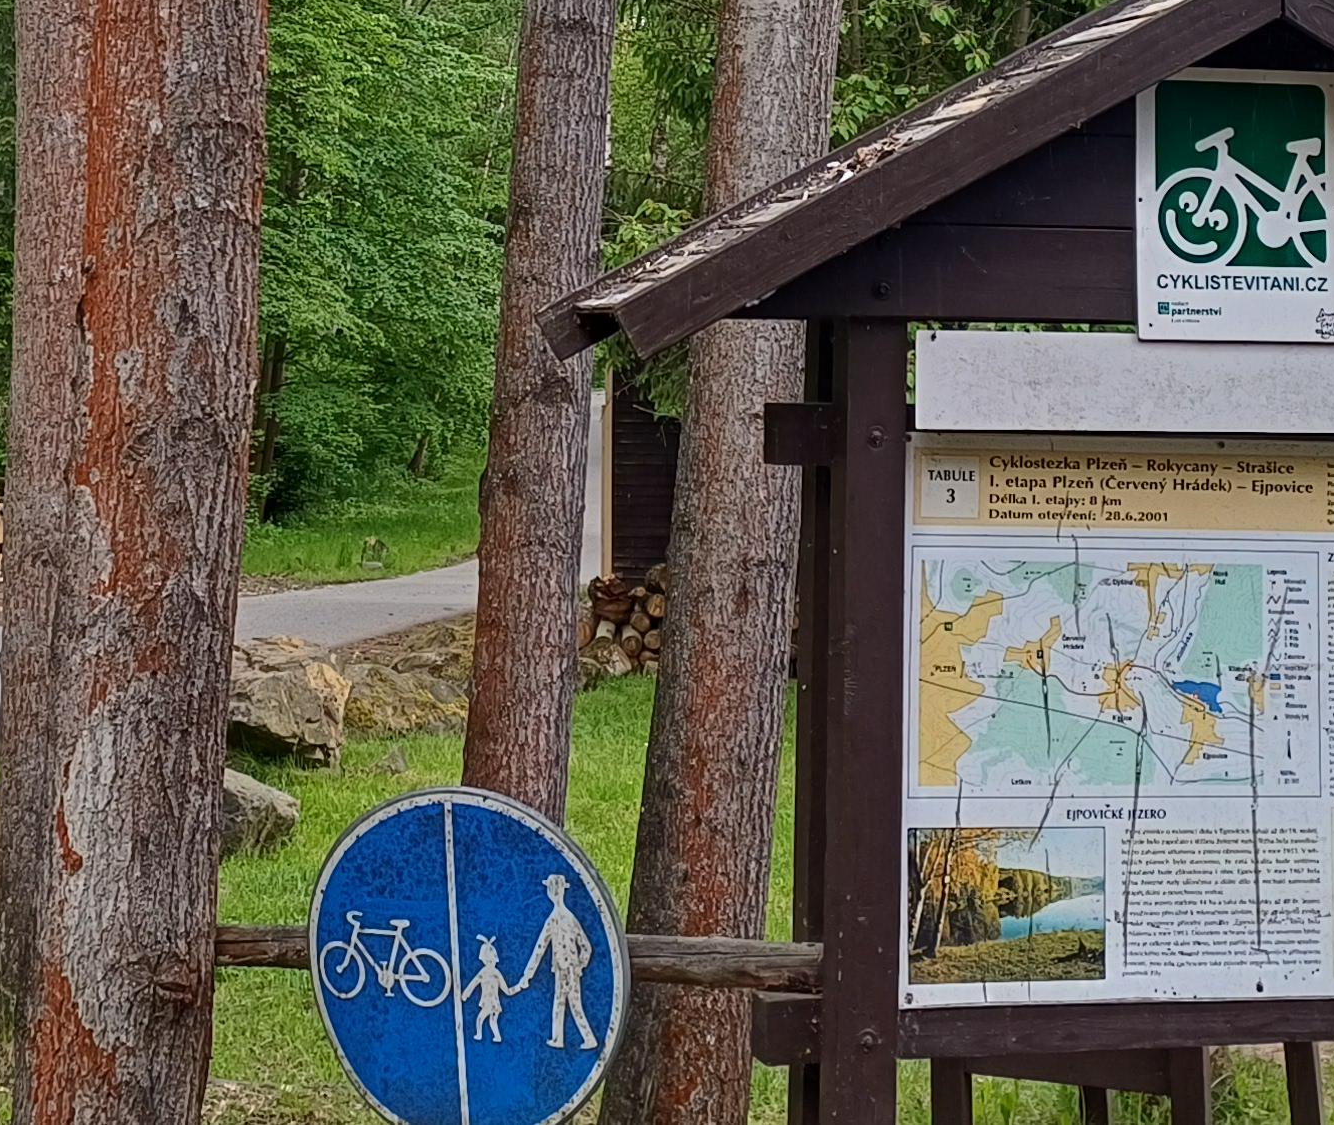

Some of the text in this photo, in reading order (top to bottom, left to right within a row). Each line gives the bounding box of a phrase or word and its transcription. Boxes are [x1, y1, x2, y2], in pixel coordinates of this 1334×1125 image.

[1156, 273, 1329, 292] CYKLISTEVITANI.CZ
[989, 455, 1081, 473] Cyklostezka
[1086, 457, 1127, 471] Plzeň
[1147, 459, 1218, 476] Rokycany
[1237, 461, 1294, 475] Strašice
[928, 469, 975, 482] TABULE
[1005, 477, 1047, 492] etapa
[1052, 475, 1094, 490] Plzeň
[1100, 475, 1167, 493] (Červený
[1173, 477, 1232, 493] Hrádek)
[1251, 479, 1314, 496] Ejpovice
[946, 488, 956, 504] 3
[989, 493, 1028, 506] Délka
[1045, 494, 1086, 509] etapy:
[1102, 495, 1122, 507] km
[989, 508, 1033, 521] Datum
[1105, 510, 1168, 523] 28.6.2001
